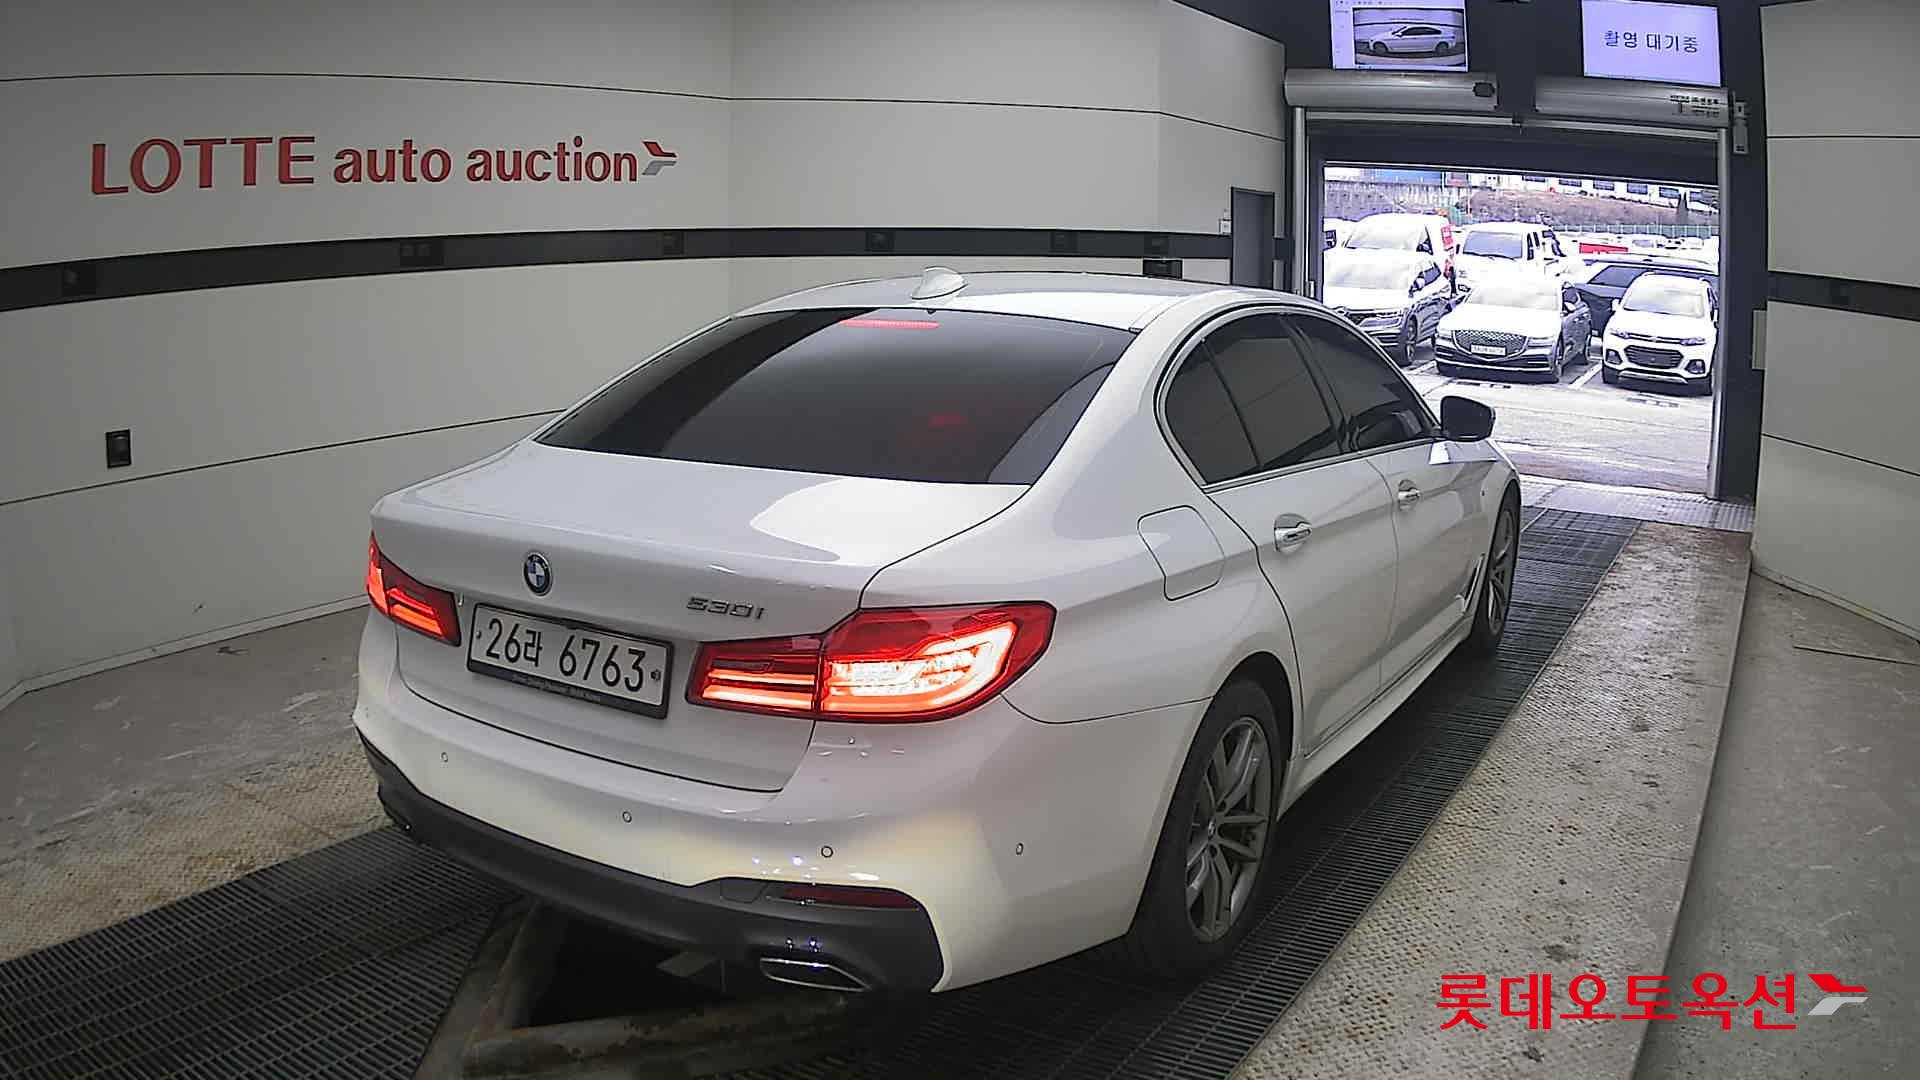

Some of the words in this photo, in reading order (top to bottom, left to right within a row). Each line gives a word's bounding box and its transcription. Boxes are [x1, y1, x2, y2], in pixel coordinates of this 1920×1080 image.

[1604, 30, 1638, 49] 촬영
[91, 136, 316, 195] LOTTE
[333, 139, 452, 184] auto
[466, 136, 638, 183] auction
[485, 617, 543, 667] 26라
[559, 634, 646, 692] 6763
